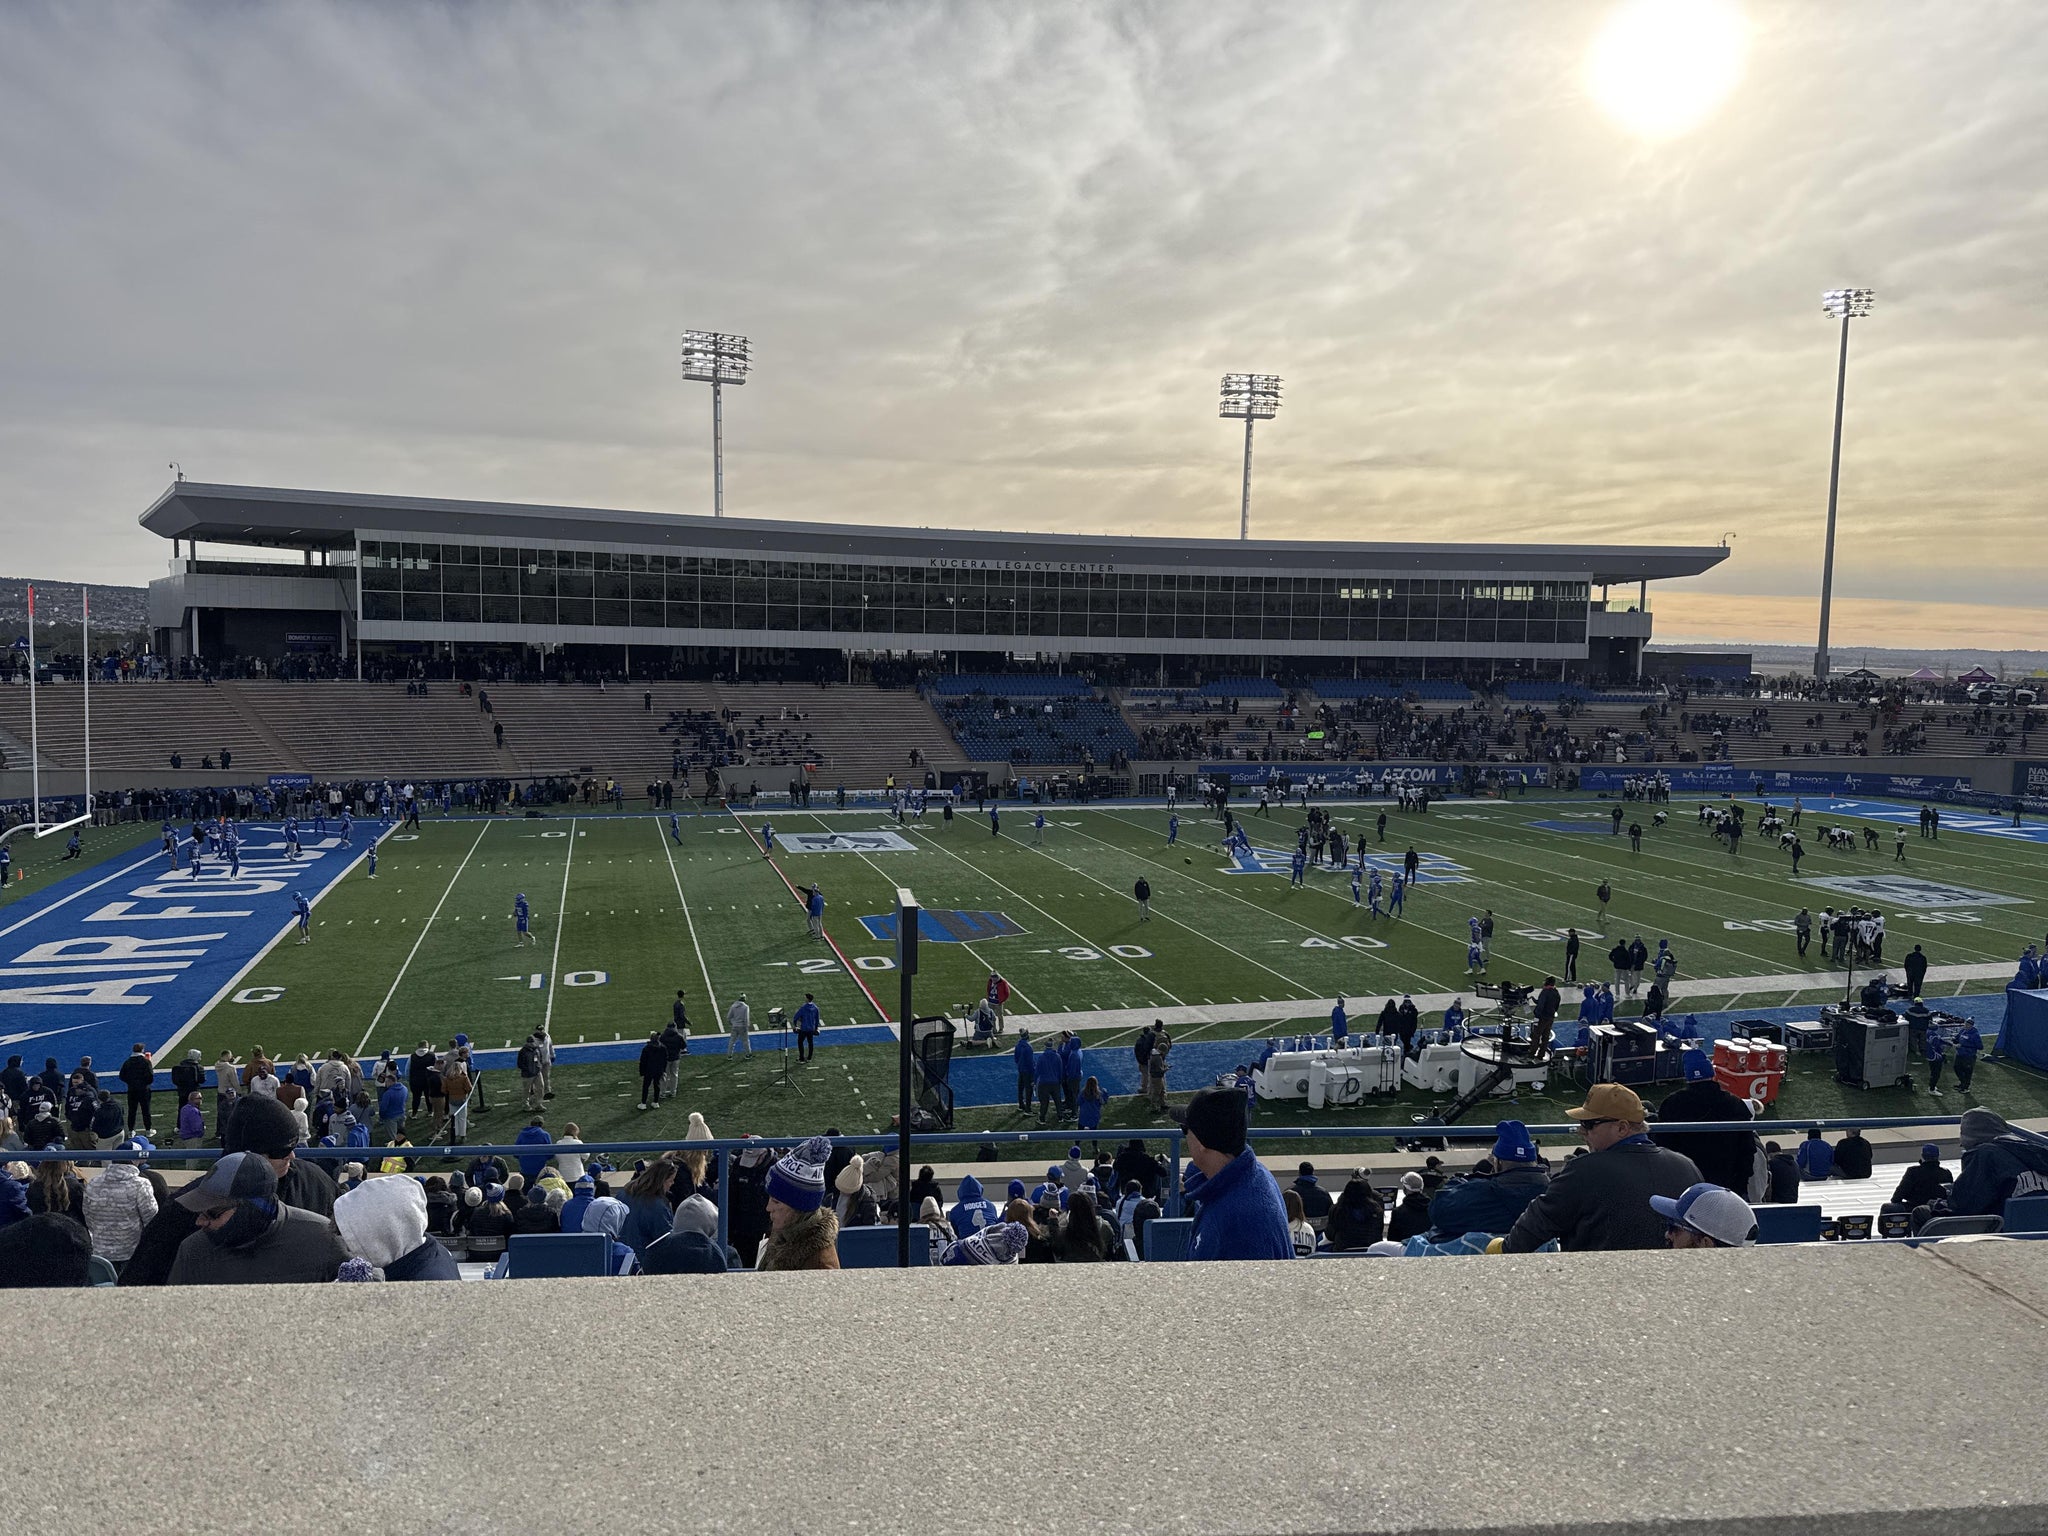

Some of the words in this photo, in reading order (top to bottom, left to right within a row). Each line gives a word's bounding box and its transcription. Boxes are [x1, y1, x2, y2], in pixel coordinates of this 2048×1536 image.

[930, 559, 987, 568] KUCERA
[996, 560, 1051, 570] LEGACY
[1060, 563, 1115, 572] CENTER
[1380, 768, 1436, 782] AECOM
[1533, 768, 1547, 784] AF
[82, 837, 344, 922] FORCE
[1299, 935, 1392, 950] 40
[1507, 927, 1606, 942] 50
[1056, 944, 1156, 961] 30
[0, 932, 228, 1005] AIR
[797, 956, 896, 974] 20
[529, 970, 610, 989] 10
[231, 986, 286, 1004] G
[1739, 1056, 1746, 1064] G
[1760, 1055, 1767, 1063] G
[1778, 1054, 1785, 1062] G
[1749, 1076, 1768, 1100] G
[963, 1200, 987, 1211] HODGES
[971, 1209, 986, 1229] 4
